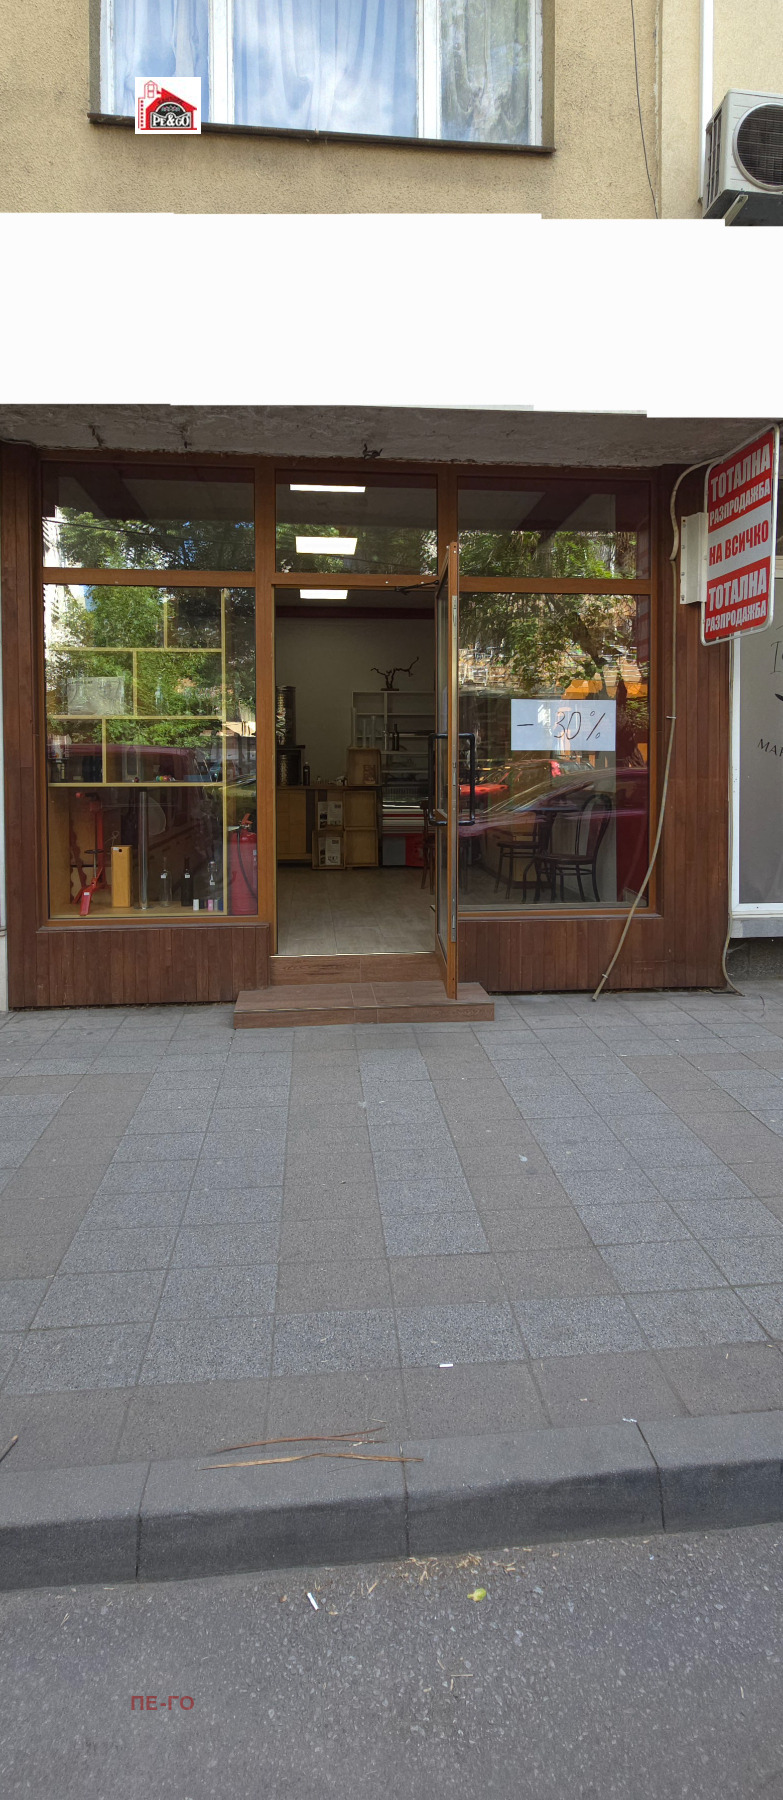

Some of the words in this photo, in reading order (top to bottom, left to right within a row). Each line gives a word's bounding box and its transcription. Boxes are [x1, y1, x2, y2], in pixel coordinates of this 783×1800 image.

[710, 443, 771, 502] ТОТАЛНА
[709, 478, 771, 526] РАЗПРОДАЖБА
[709, 544, 723, 567] НА
[725, 519, 769, 560] ВСИЧКО
[709, 568, 767, 611] ТОТАЛНА
[706, 600, 767, 633] РАЗПРОДАЖБА
